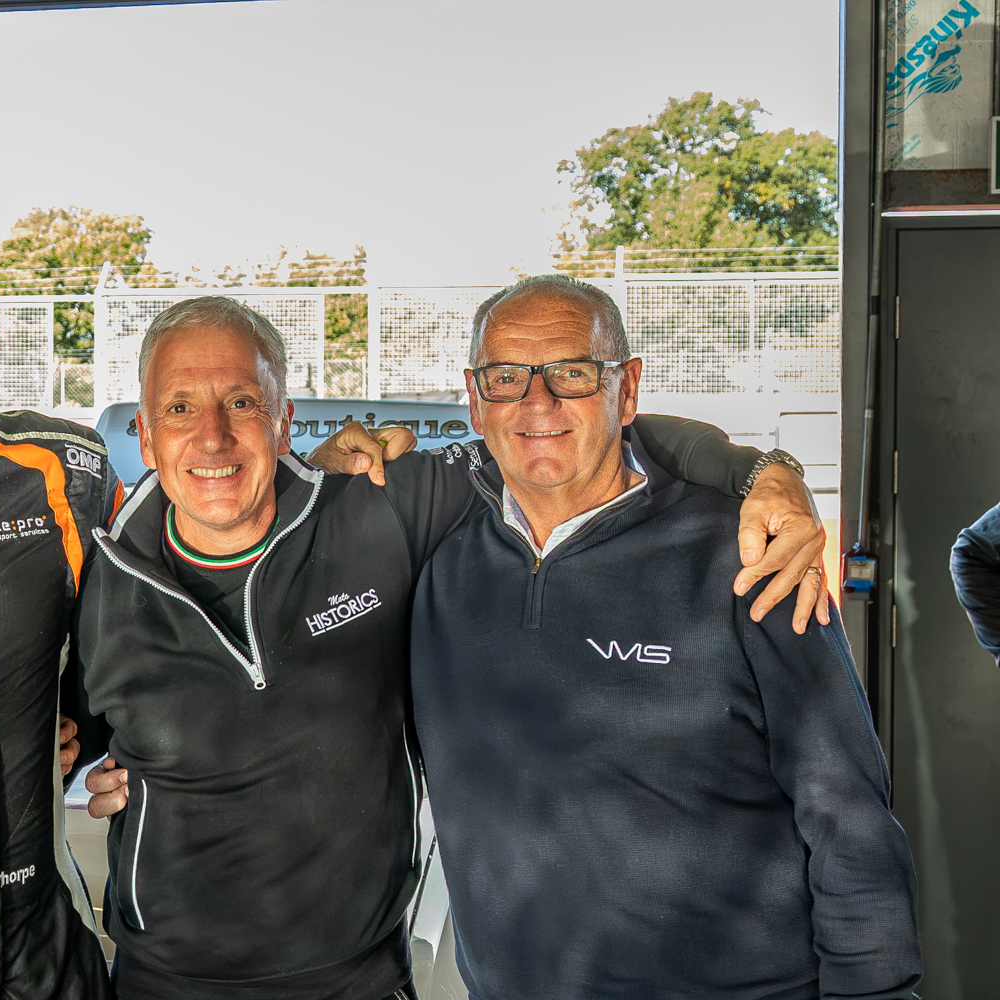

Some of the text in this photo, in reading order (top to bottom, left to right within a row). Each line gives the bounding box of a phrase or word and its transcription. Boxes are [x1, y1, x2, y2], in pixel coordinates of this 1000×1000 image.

[886, 0, 980, 92] Kingspa
[66, 448, 101, 472] OMP
[20, 528, 50, 538] services
[305, 588, 379, 633] HISTORICS
[0, 864, 36, 888] horpe
